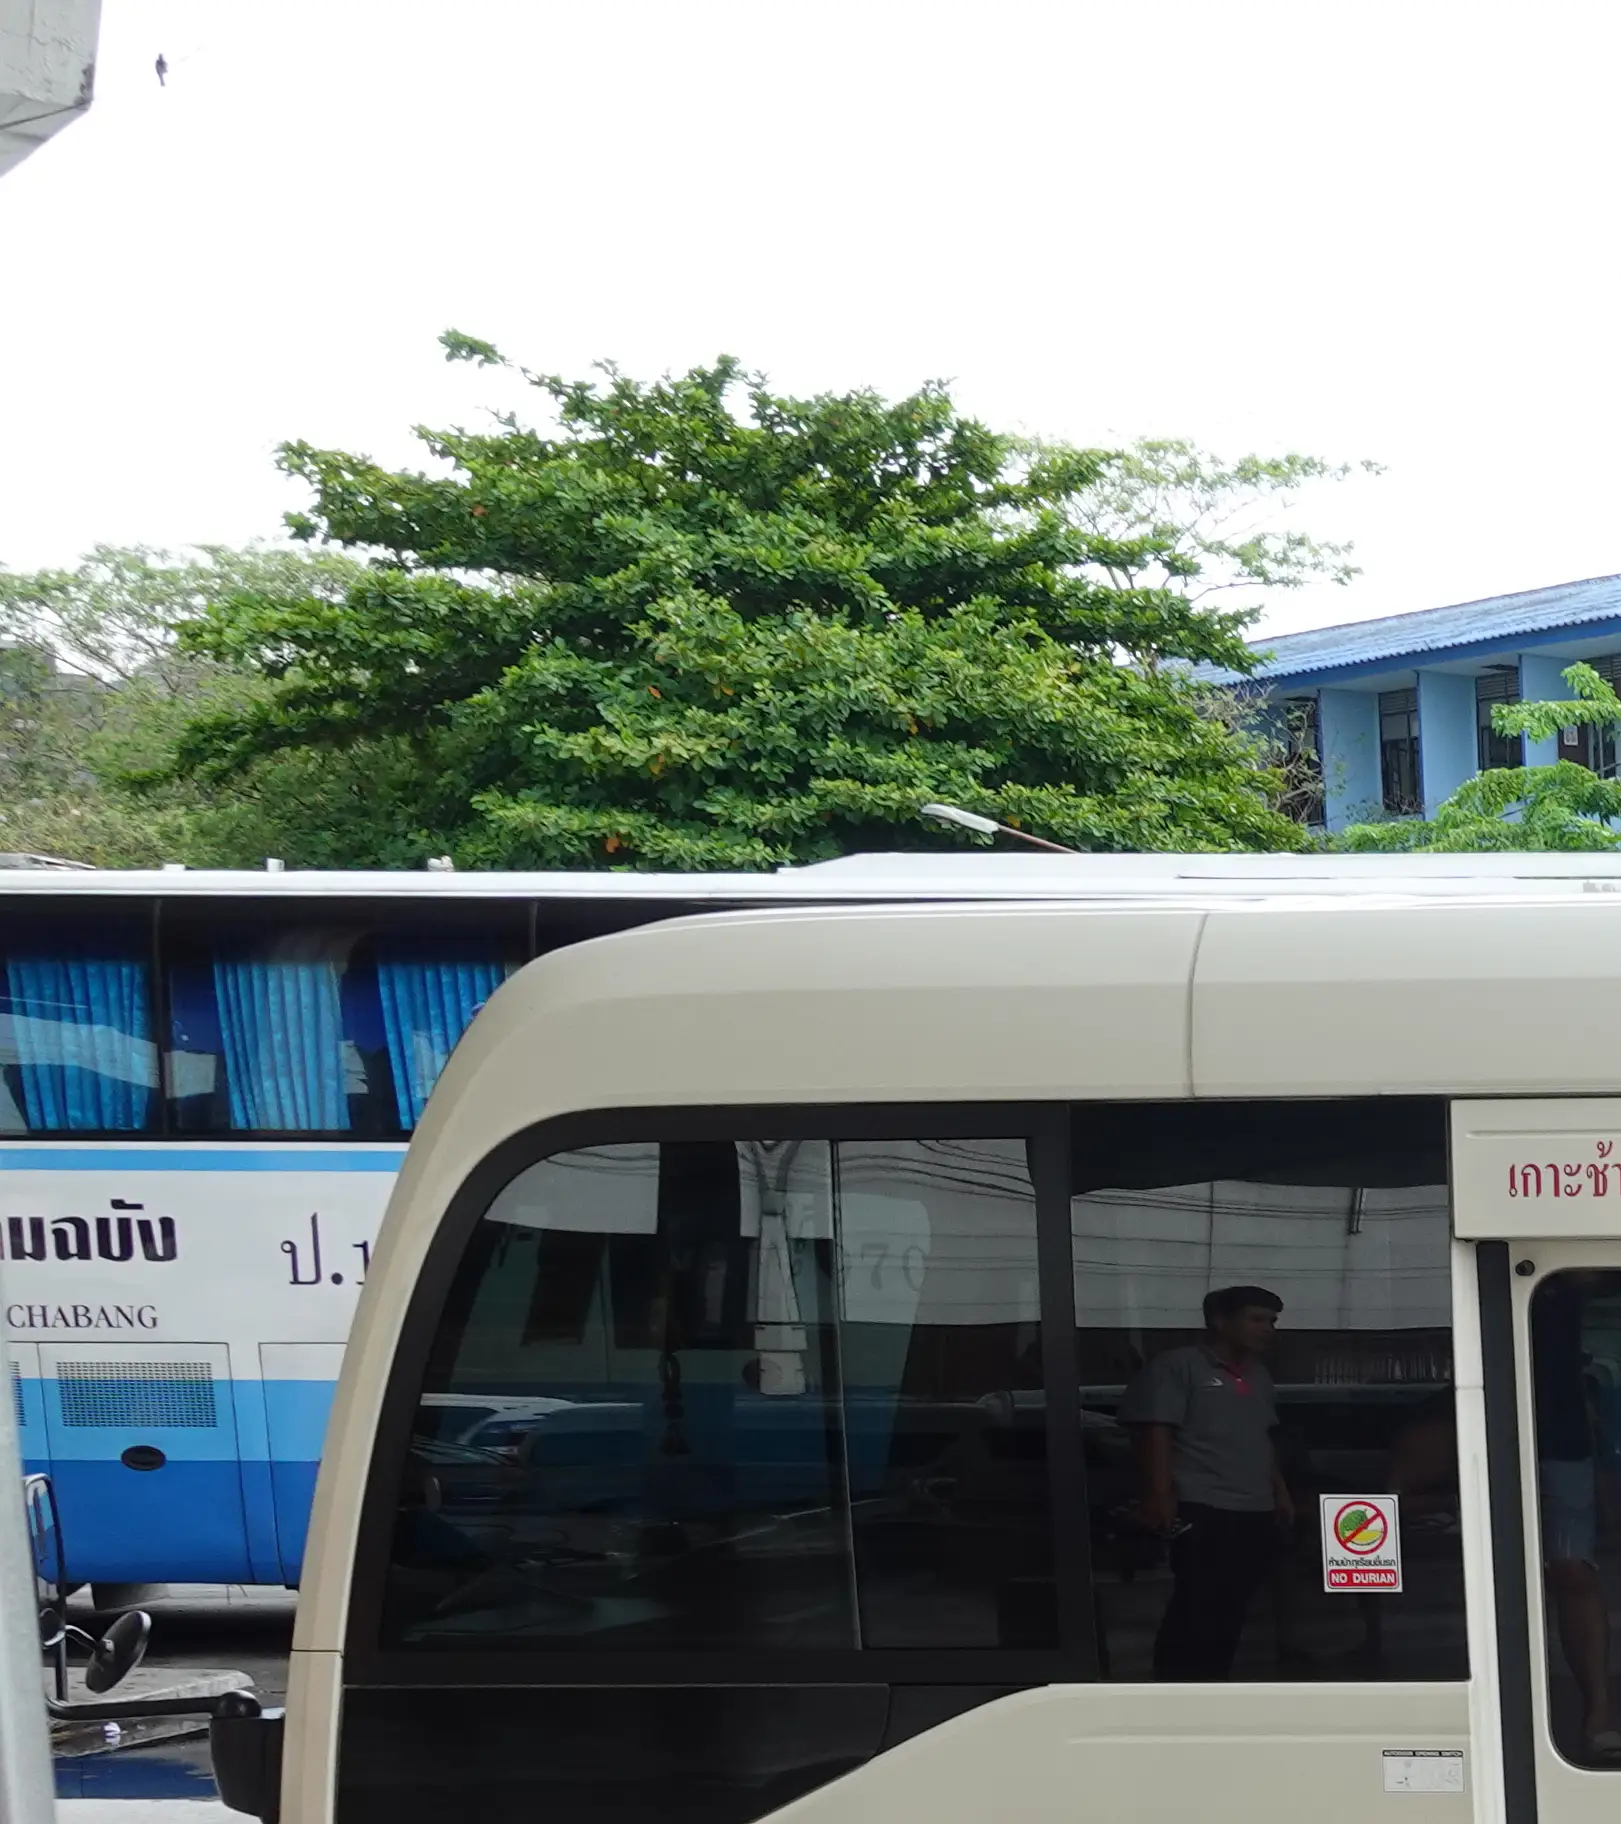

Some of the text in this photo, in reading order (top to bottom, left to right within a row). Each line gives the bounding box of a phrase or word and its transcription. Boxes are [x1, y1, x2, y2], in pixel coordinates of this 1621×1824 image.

[0, 1198, 178, 1262] มฉบัง
[6, 1304, 158, 1329] CHABANG
[1331, 1572, 1395, 1584] NO DURIAN
